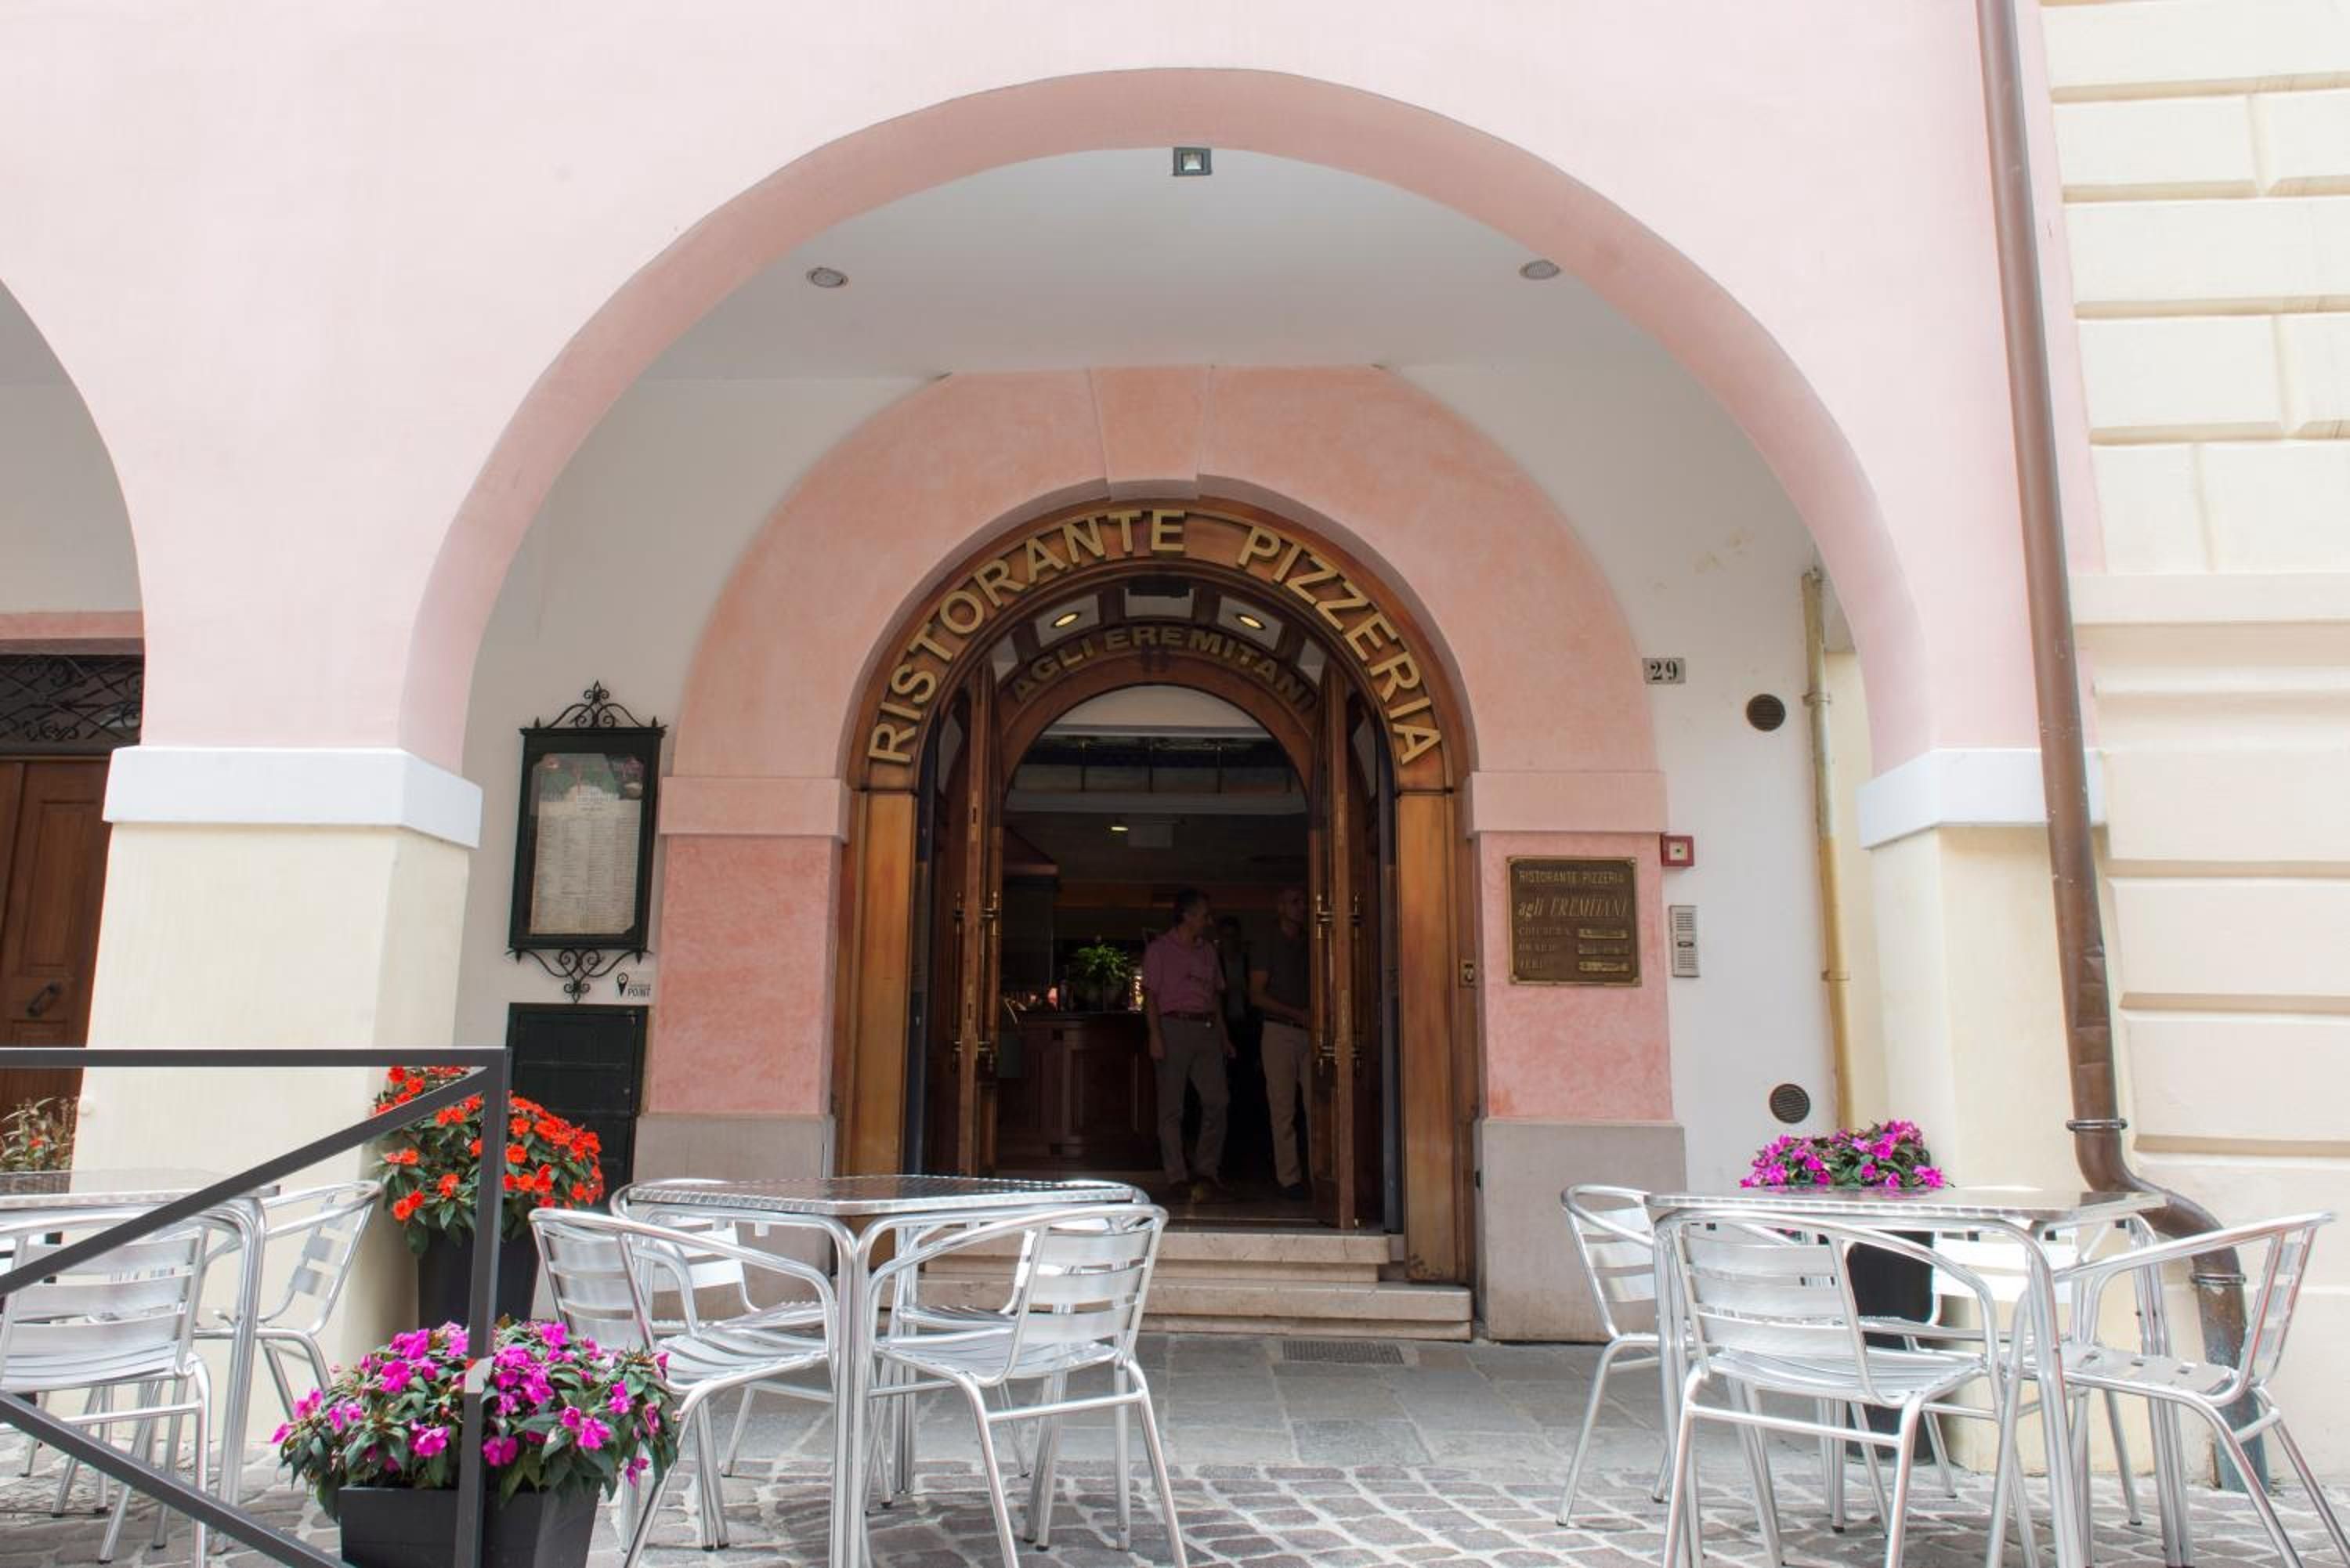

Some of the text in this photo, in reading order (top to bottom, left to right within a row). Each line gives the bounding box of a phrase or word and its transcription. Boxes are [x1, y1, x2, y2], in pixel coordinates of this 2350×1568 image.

[869, 509, 1442, 765] RISTORANTE PIZZERIA
[1014, 627, 1318, 713] AGLI EREMITANI
[1650, 661, 1677, 681] 29
